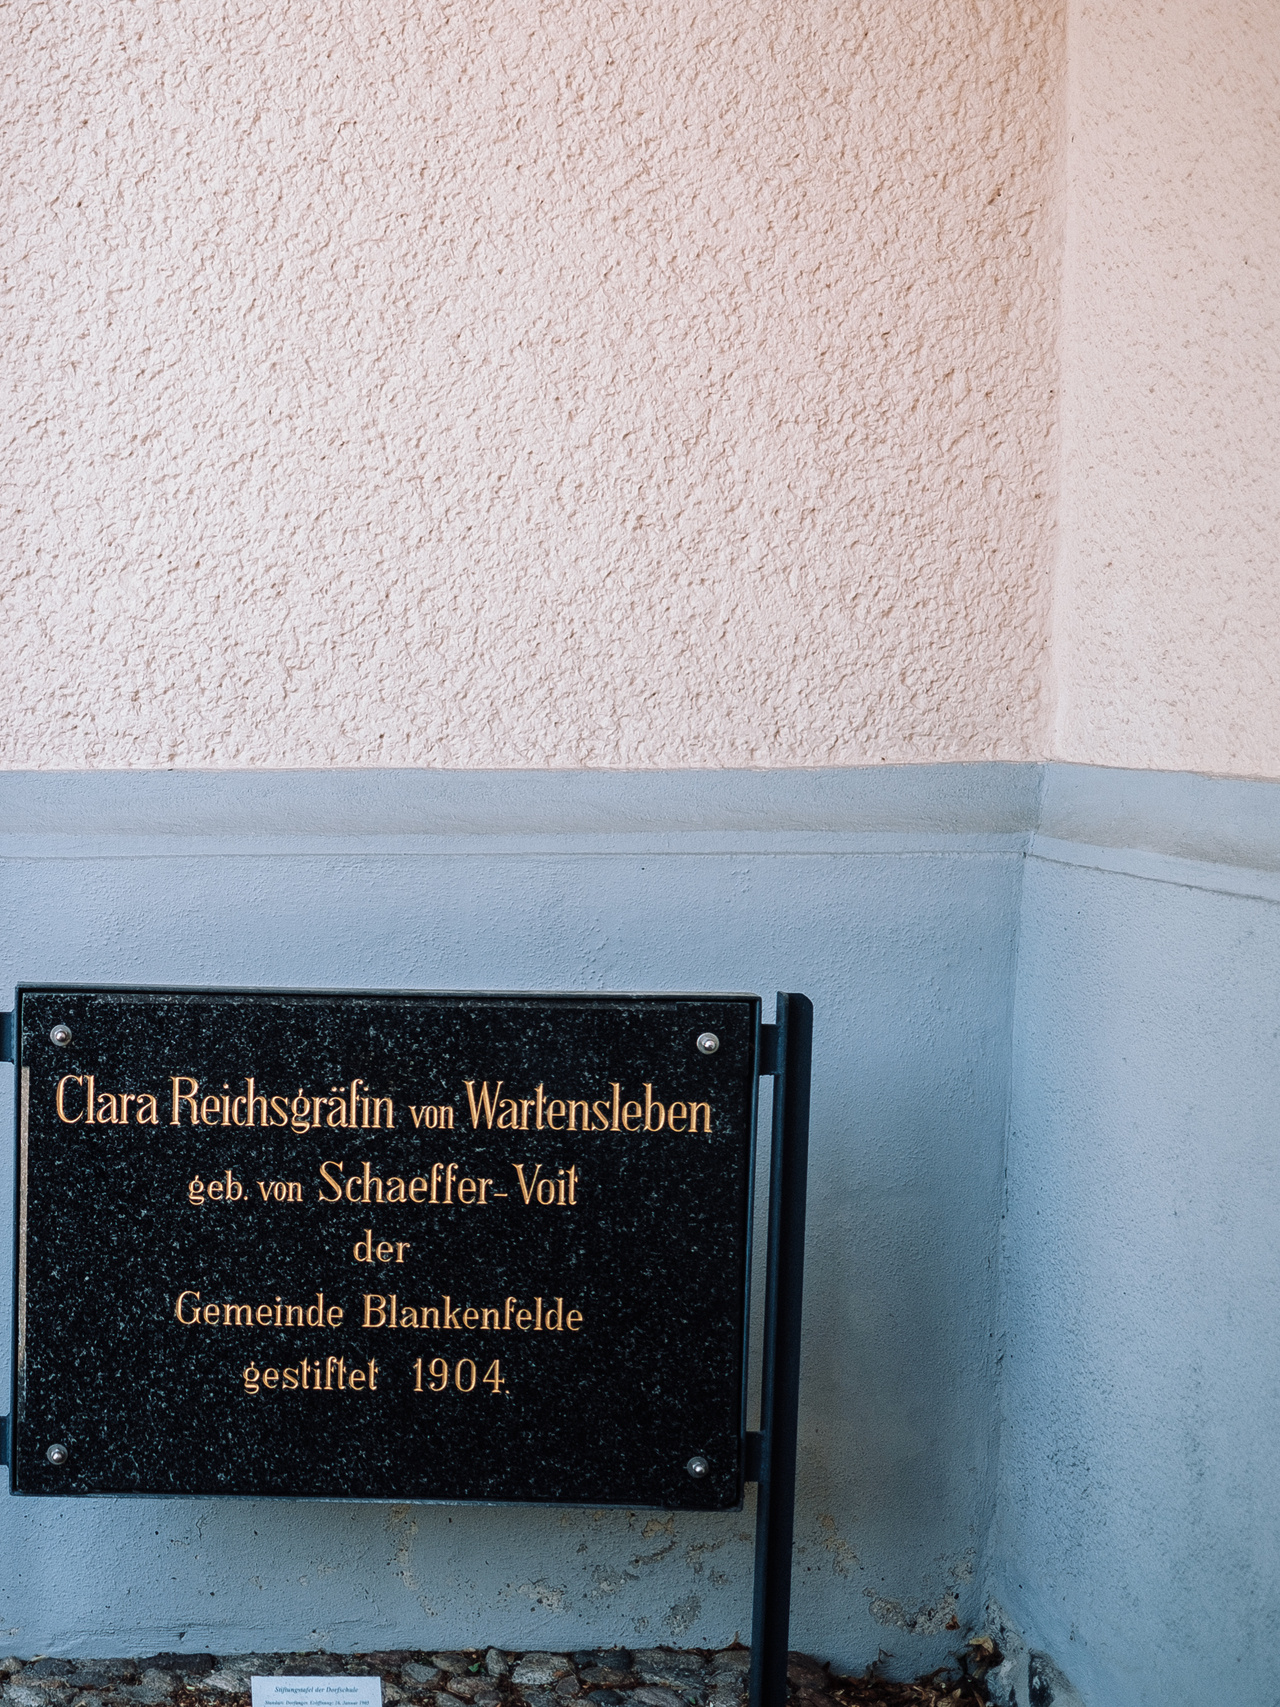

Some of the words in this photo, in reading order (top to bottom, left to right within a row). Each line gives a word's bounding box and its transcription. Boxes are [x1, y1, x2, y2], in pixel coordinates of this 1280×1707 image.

[55, 1074, 159, 1124] Clara
[169, 1076, 395, 1134] Reichsgräfin
[408, 1104, 455, 1130] von
[462, 1080, 713, 1133] Wartensleben
[188, 1169, 248, 1206] geb.
[256, 1181, 303, 1202] von
[353, 1229, 410, 1263] der
[175, 1290, 344, 1327] Gemeinde
[361, 1293, 584, 1331] Blankenfelde
[242, 1356, 379, 1395] gestiftet
[274, 1686, 314, 1694] Stiftungstafel
[326, 1686, 359, 1694] Dorfschule
